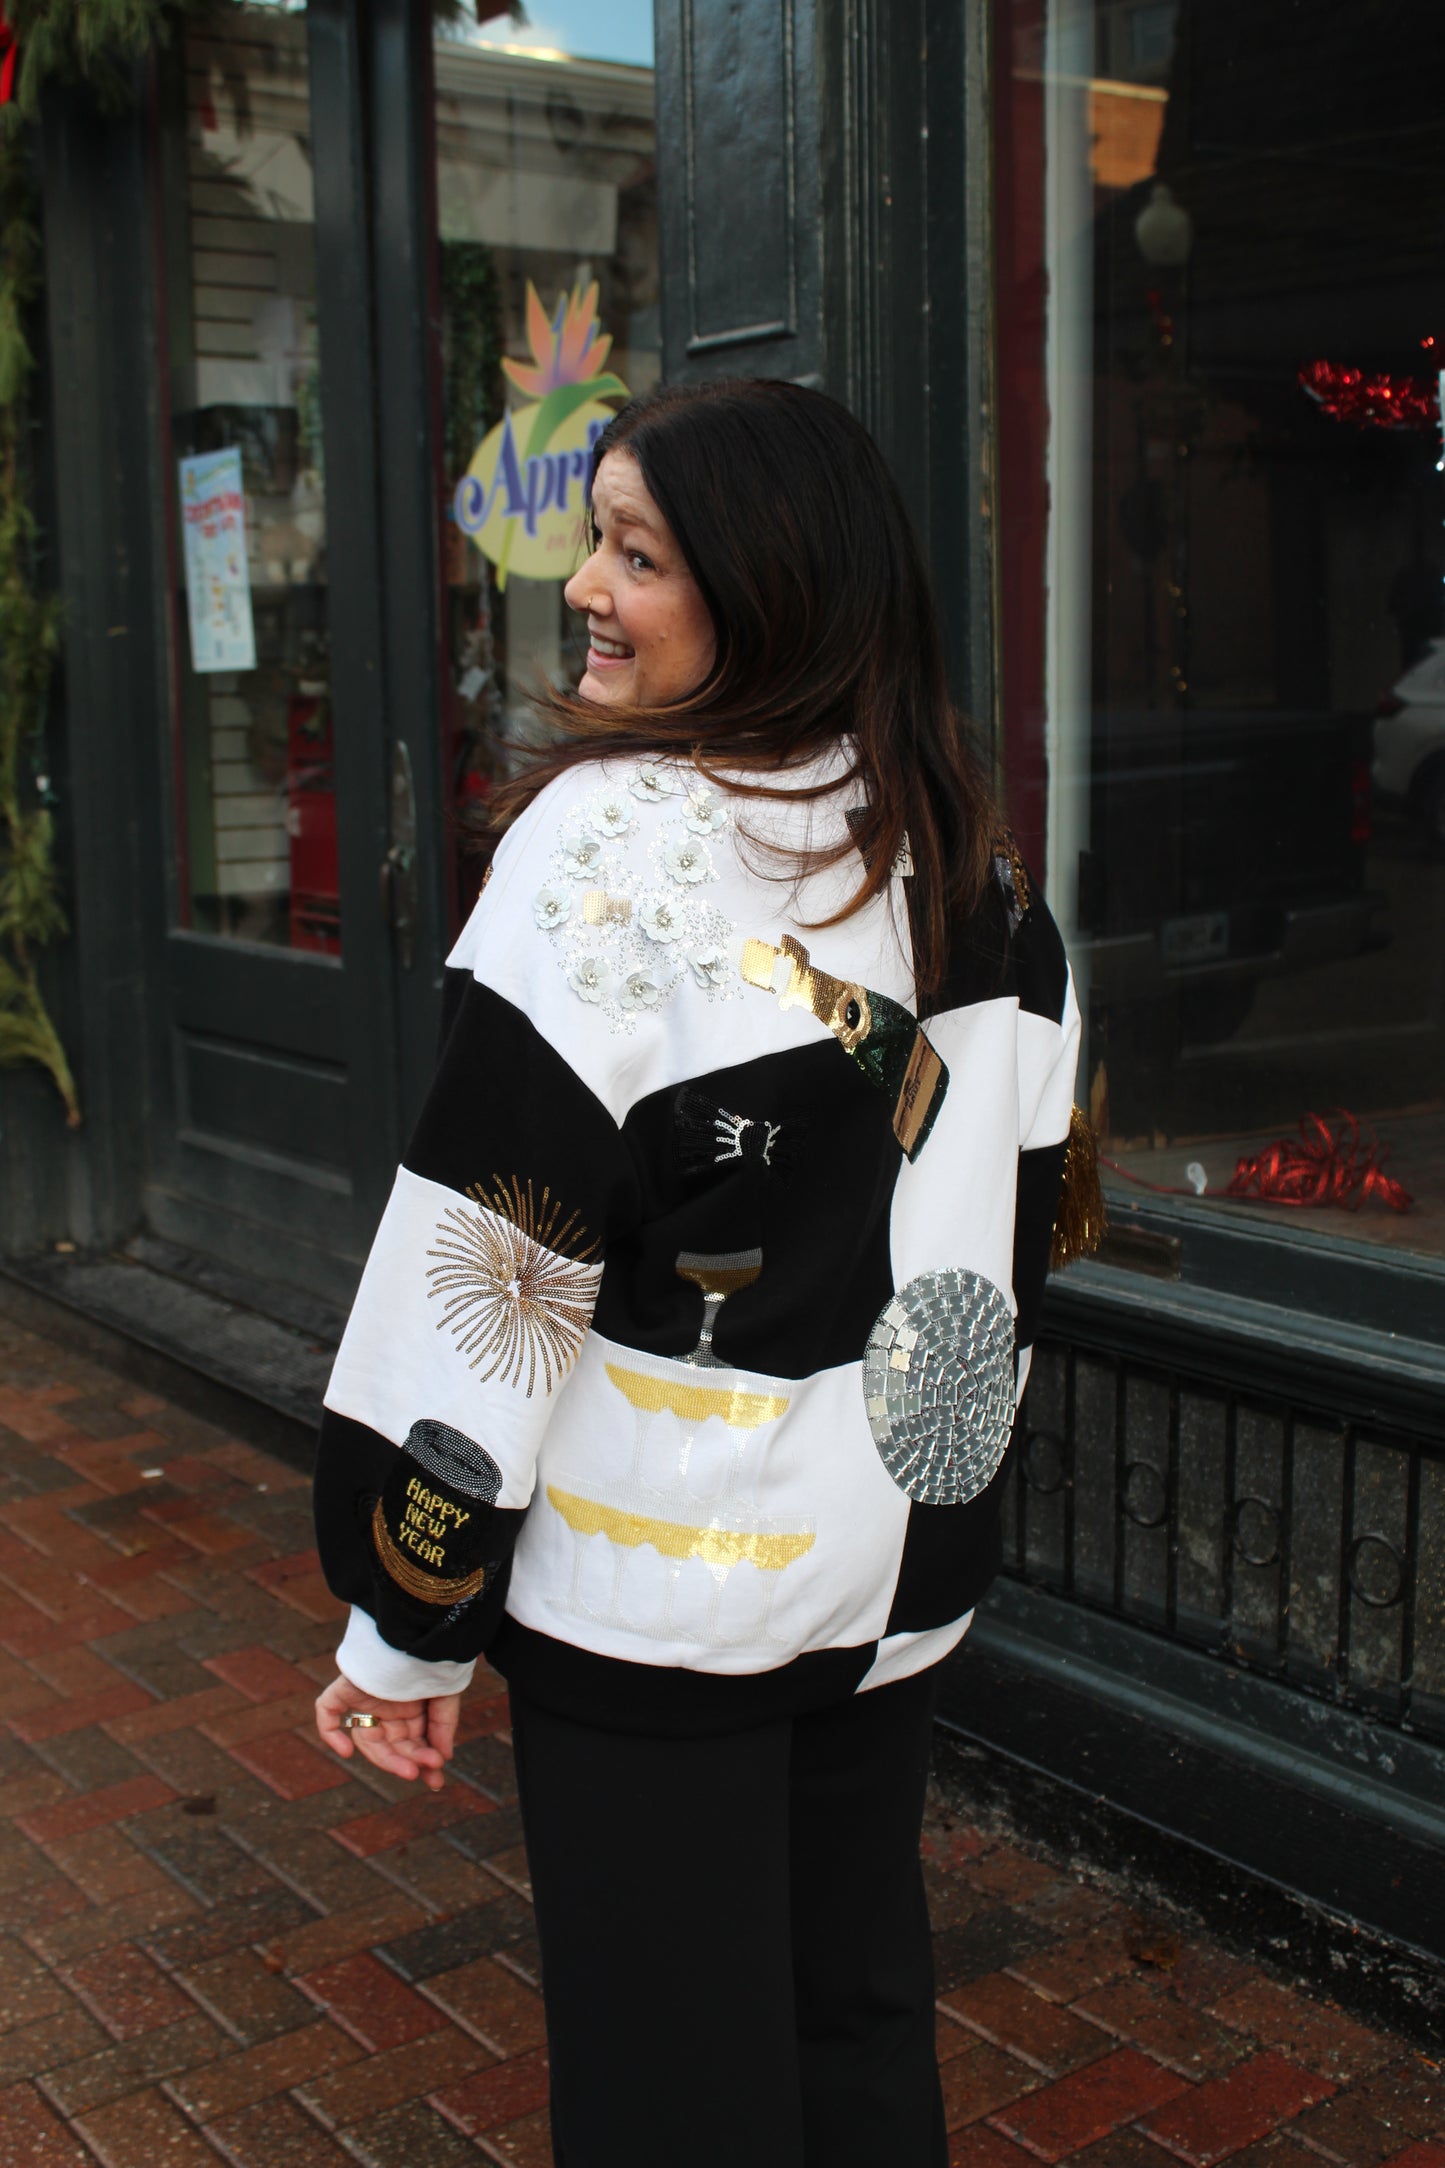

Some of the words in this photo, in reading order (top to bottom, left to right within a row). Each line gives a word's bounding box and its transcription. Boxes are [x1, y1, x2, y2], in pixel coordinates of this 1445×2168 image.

[454, 406, 611, 537] Apri
[406, 1504, 446, 1538] NEW
[407, 1478, 469, 1528] HAPPY
[400, 1522, 445, 1567] YEAR
